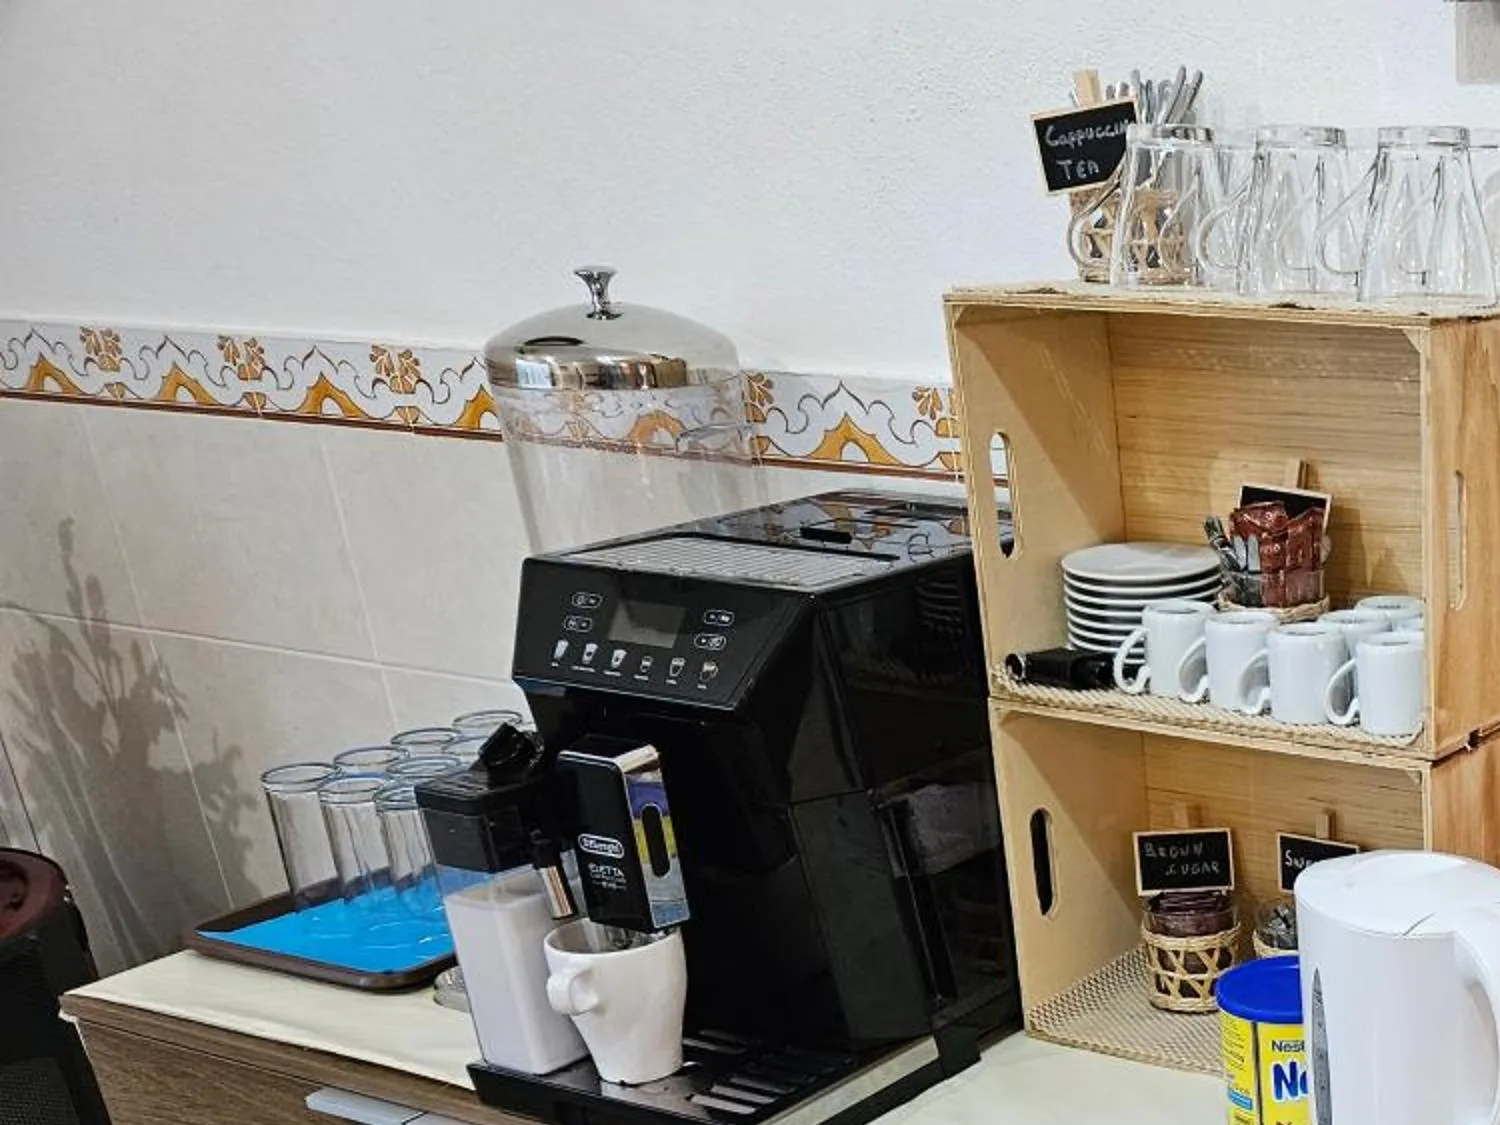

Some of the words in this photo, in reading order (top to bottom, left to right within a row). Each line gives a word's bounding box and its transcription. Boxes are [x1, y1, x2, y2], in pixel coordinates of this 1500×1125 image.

[1045, 119, 1128, 149] Cappuccin
[1056, 159, 1099, 180] TEA
[1165, 861, 1219, 877] SUGAR
